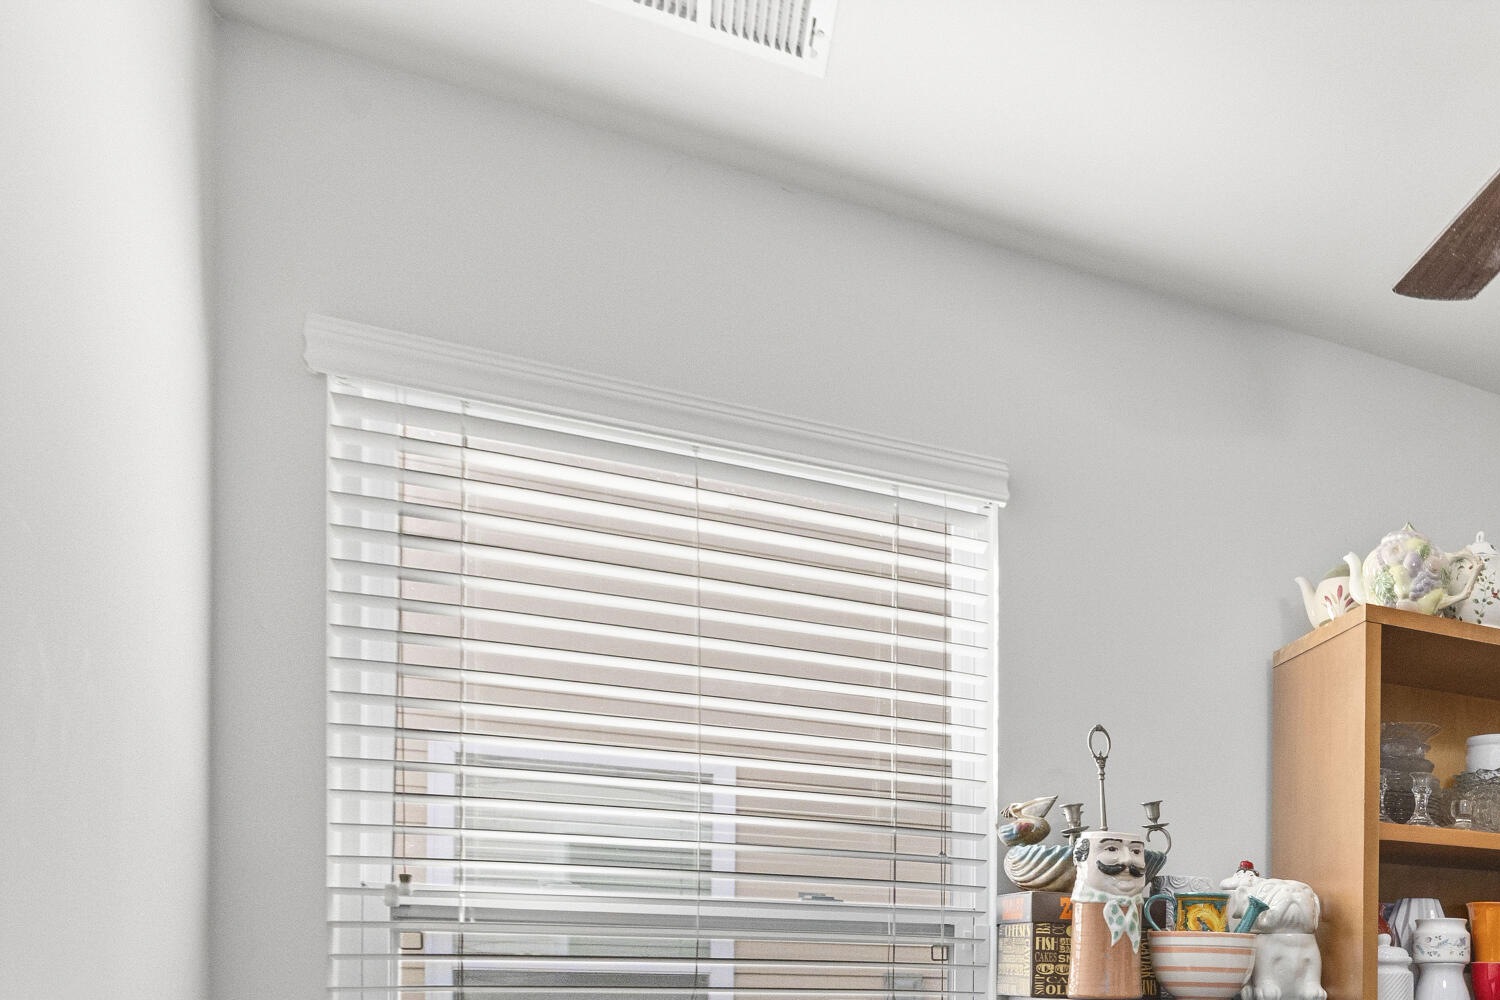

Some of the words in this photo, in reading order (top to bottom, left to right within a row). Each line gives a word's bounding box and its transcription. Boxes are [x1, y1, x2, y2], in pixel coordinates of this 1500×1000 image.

[1035, 937, 1058, 950] FISH
[1035, 952, 1058, 963] CAKES
[1035, 974, 1045, 995] SOUP
